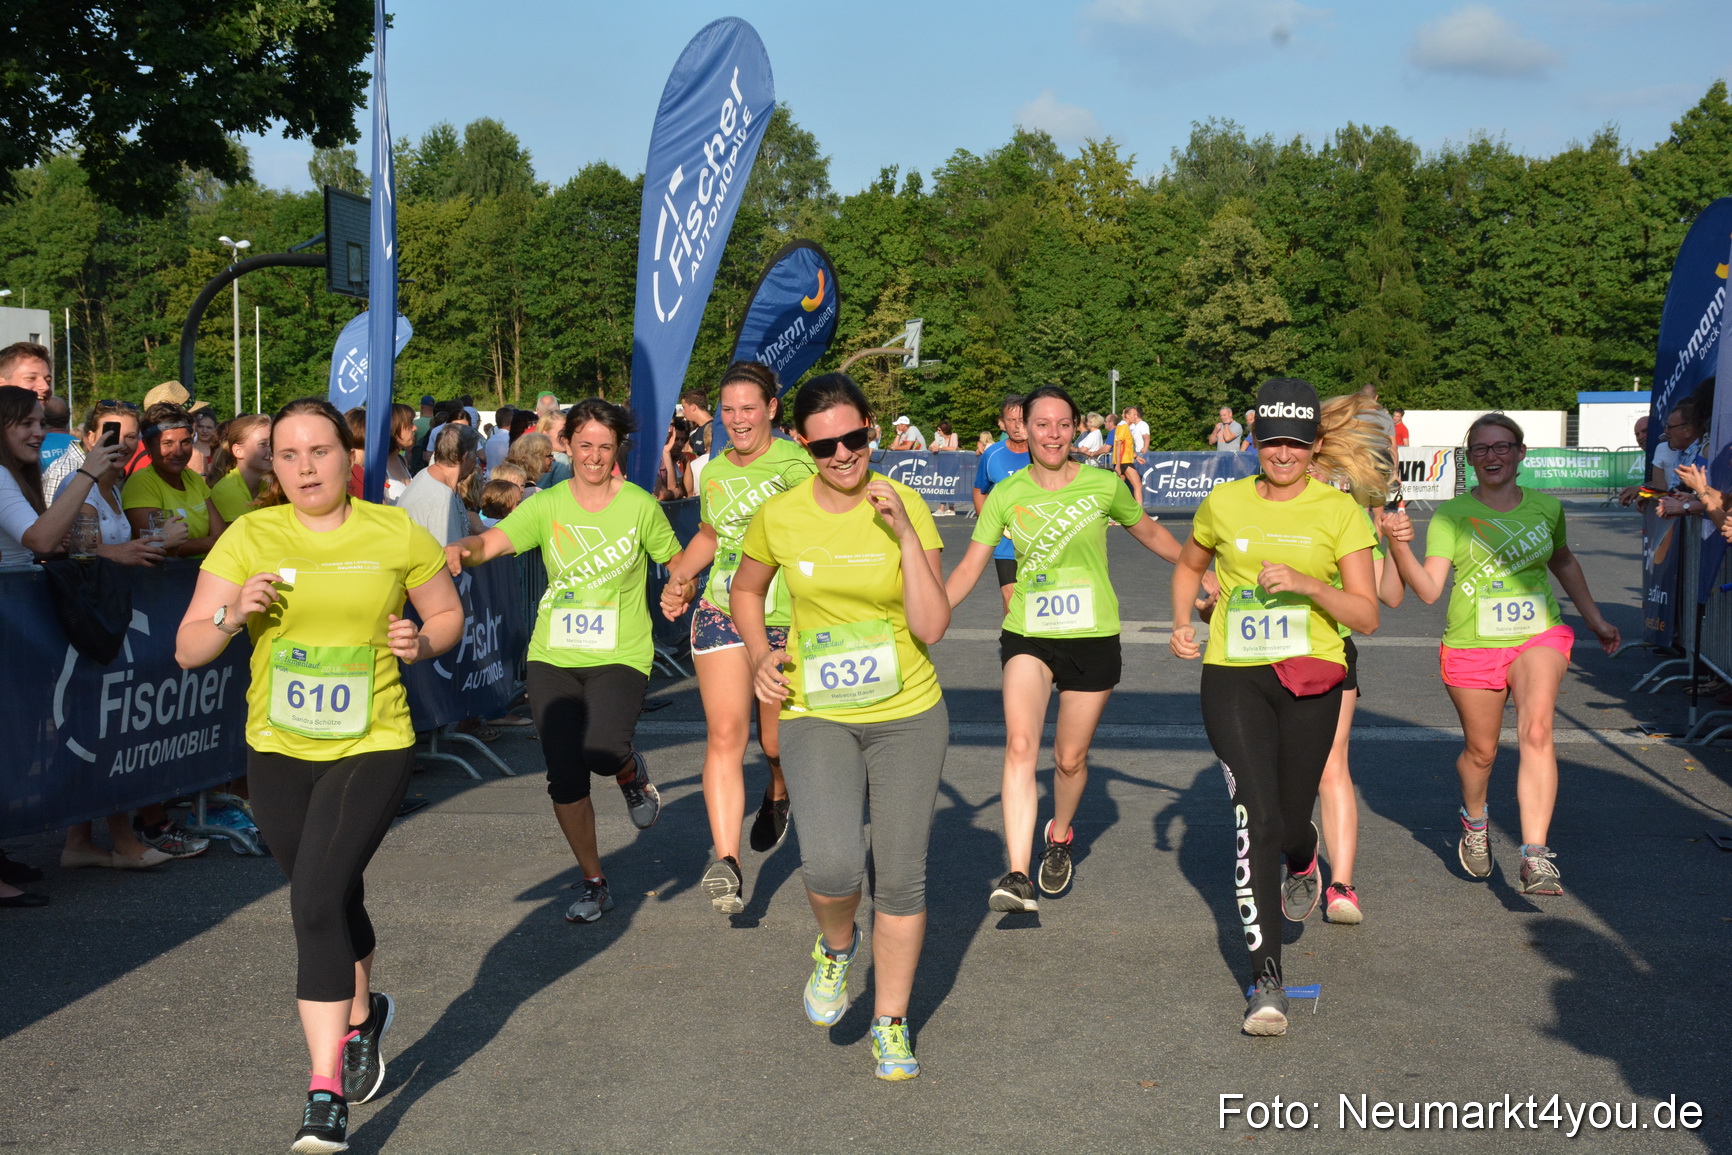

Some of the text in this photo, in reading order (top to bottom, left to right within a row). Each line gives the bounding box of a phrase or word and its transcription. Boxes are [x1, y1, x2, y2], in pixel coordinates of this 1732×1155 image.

[669, 66, 743, 286] Fischer
[691, 105, 752, 283] AUTOMOBILE
[777, 346, 797, 371] Druck
[809, 306, 833, 339] Medien
[1699, 327, 1721, 360] Druck
[1656, 286, 1726, 421] Frischmann
[1258, 402, 1315, 420] adidas
[1522, 456, 1601, 468] GESUNDHEIT
[1570, 467, 1610, 478] HÄNDEN
[901, 471, 960, 487] Fischer
[914, 487, 955, 495] TOMOBILE
[1036, 594, 1080, 617] 200
[1492, 600, 1535, 622] 193
[562, 613, 605, 635] 194
[1241, 615, 1288, 640] 611
[284, 656, 320, 669] firmenlauf
[820, 656, 881, 689] 632
[98, 665, 233, 739] Fischer
[287, 680, 351, 713] 610
[291, 715, 314, 725] Sandra
[109, 724, 221, 778] AUTOMOBILE
[1235, 804, 1263, 951] adidas
